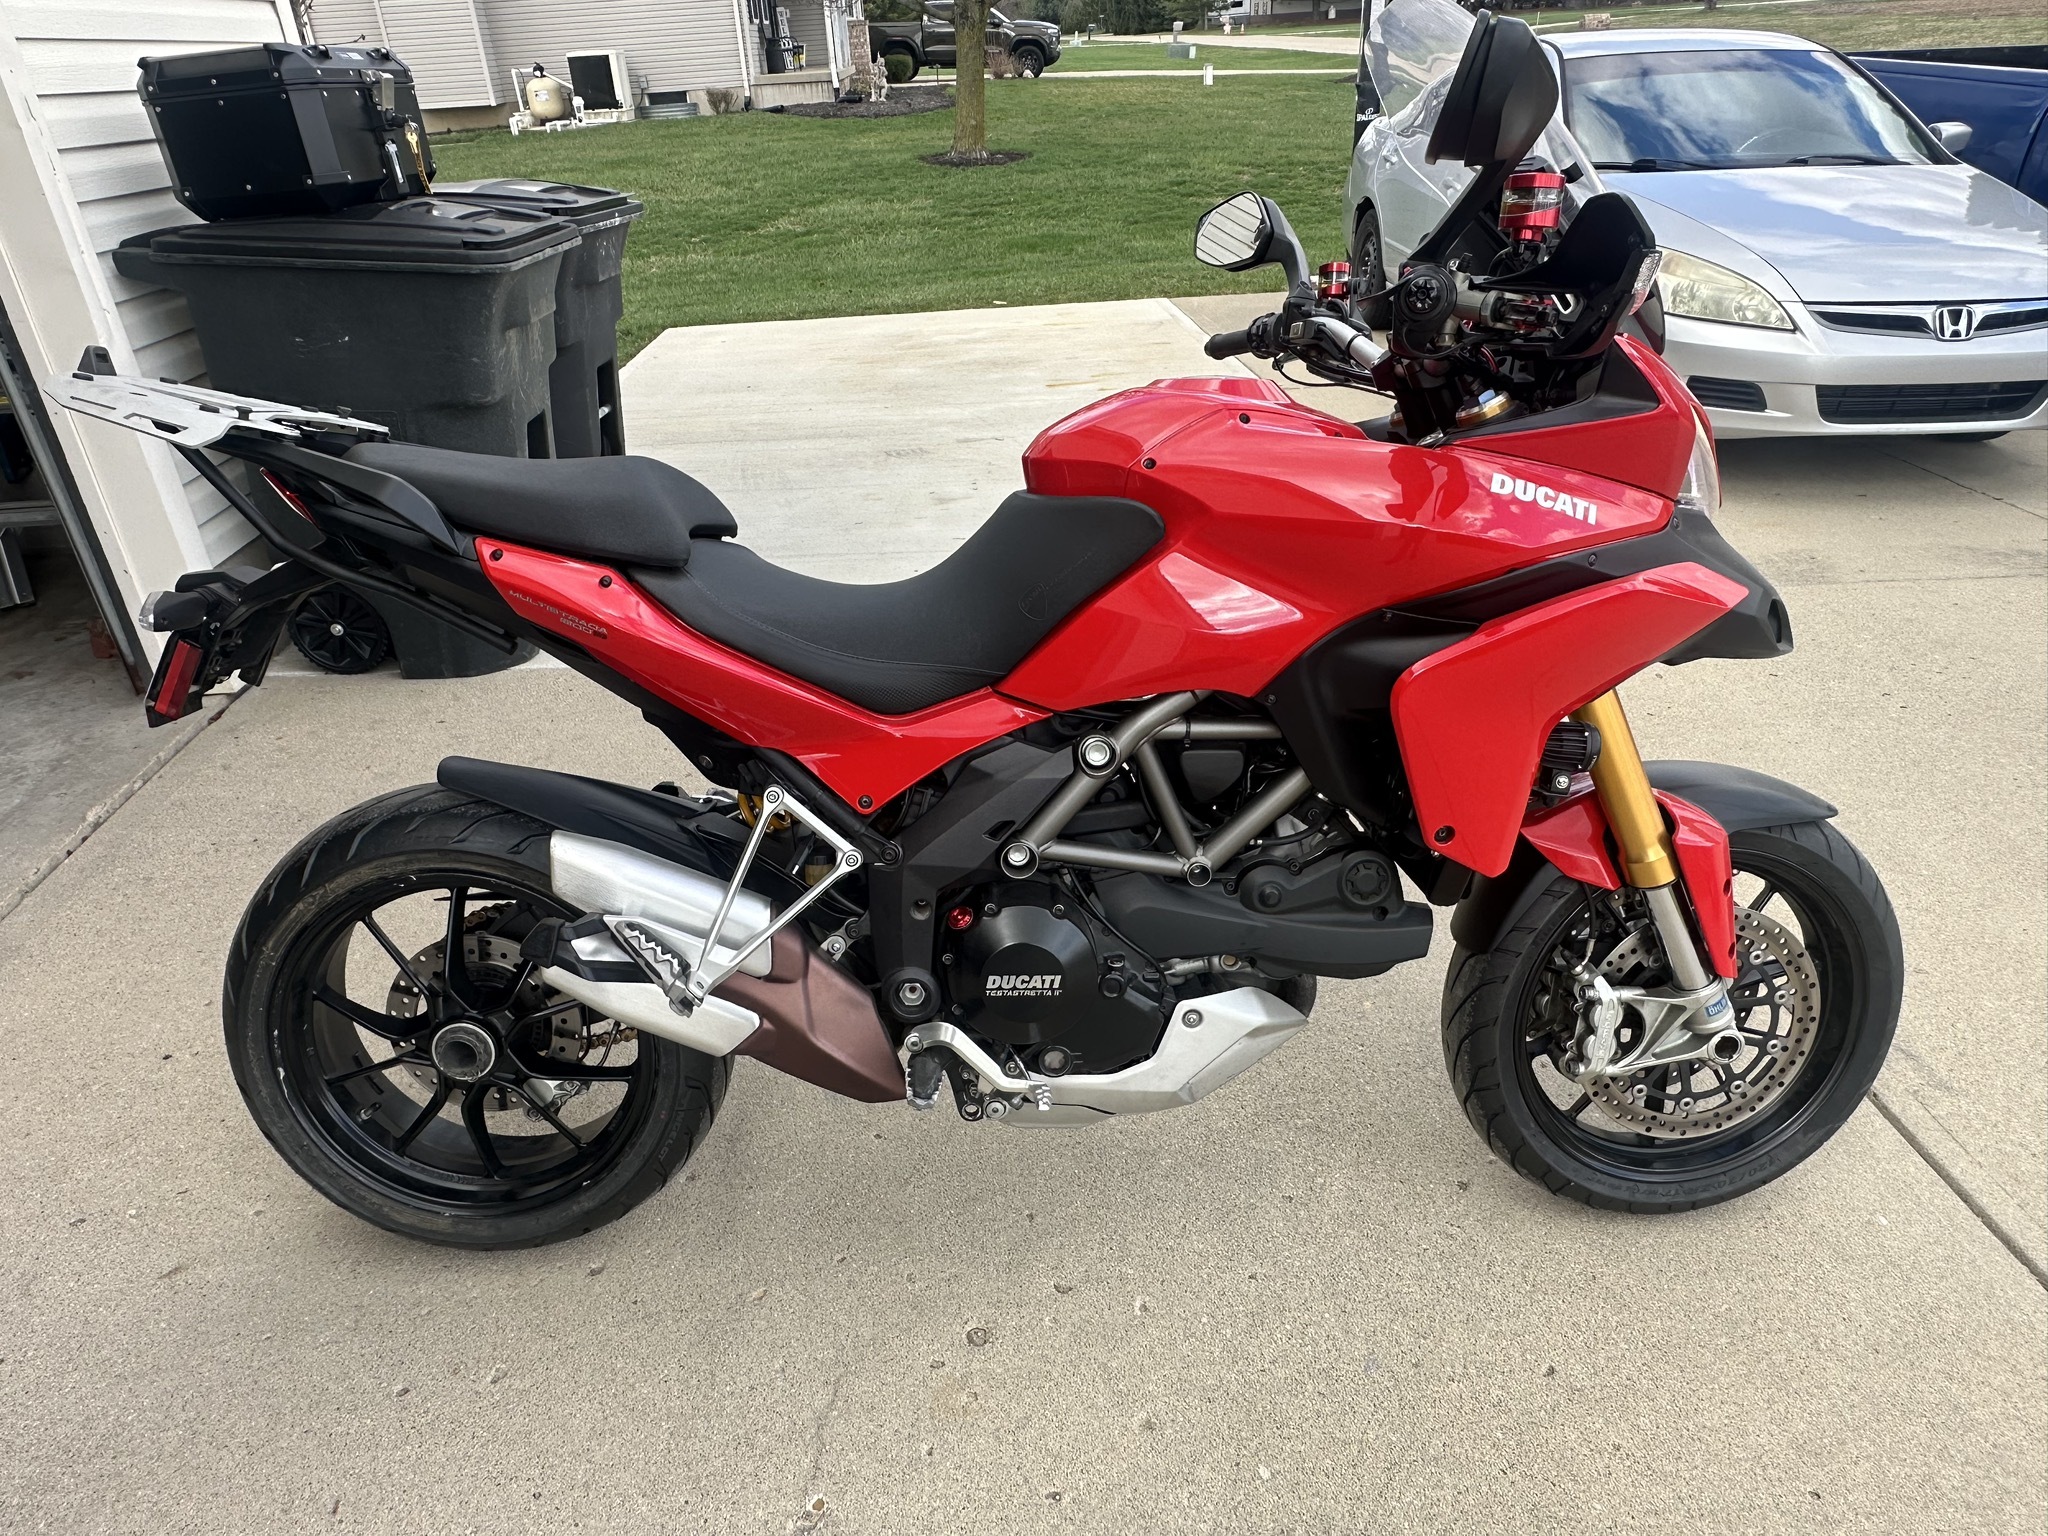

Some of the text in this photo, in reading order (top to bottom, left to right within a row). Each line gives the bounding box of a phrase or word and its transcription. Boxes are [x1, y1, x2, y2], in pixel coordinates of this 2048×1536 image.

[1490, 472, 1597, 525] DUCATI
[509, 590, 608, 634] MULTISTRADA
[986, 975, 1061, 989] DUCATI
